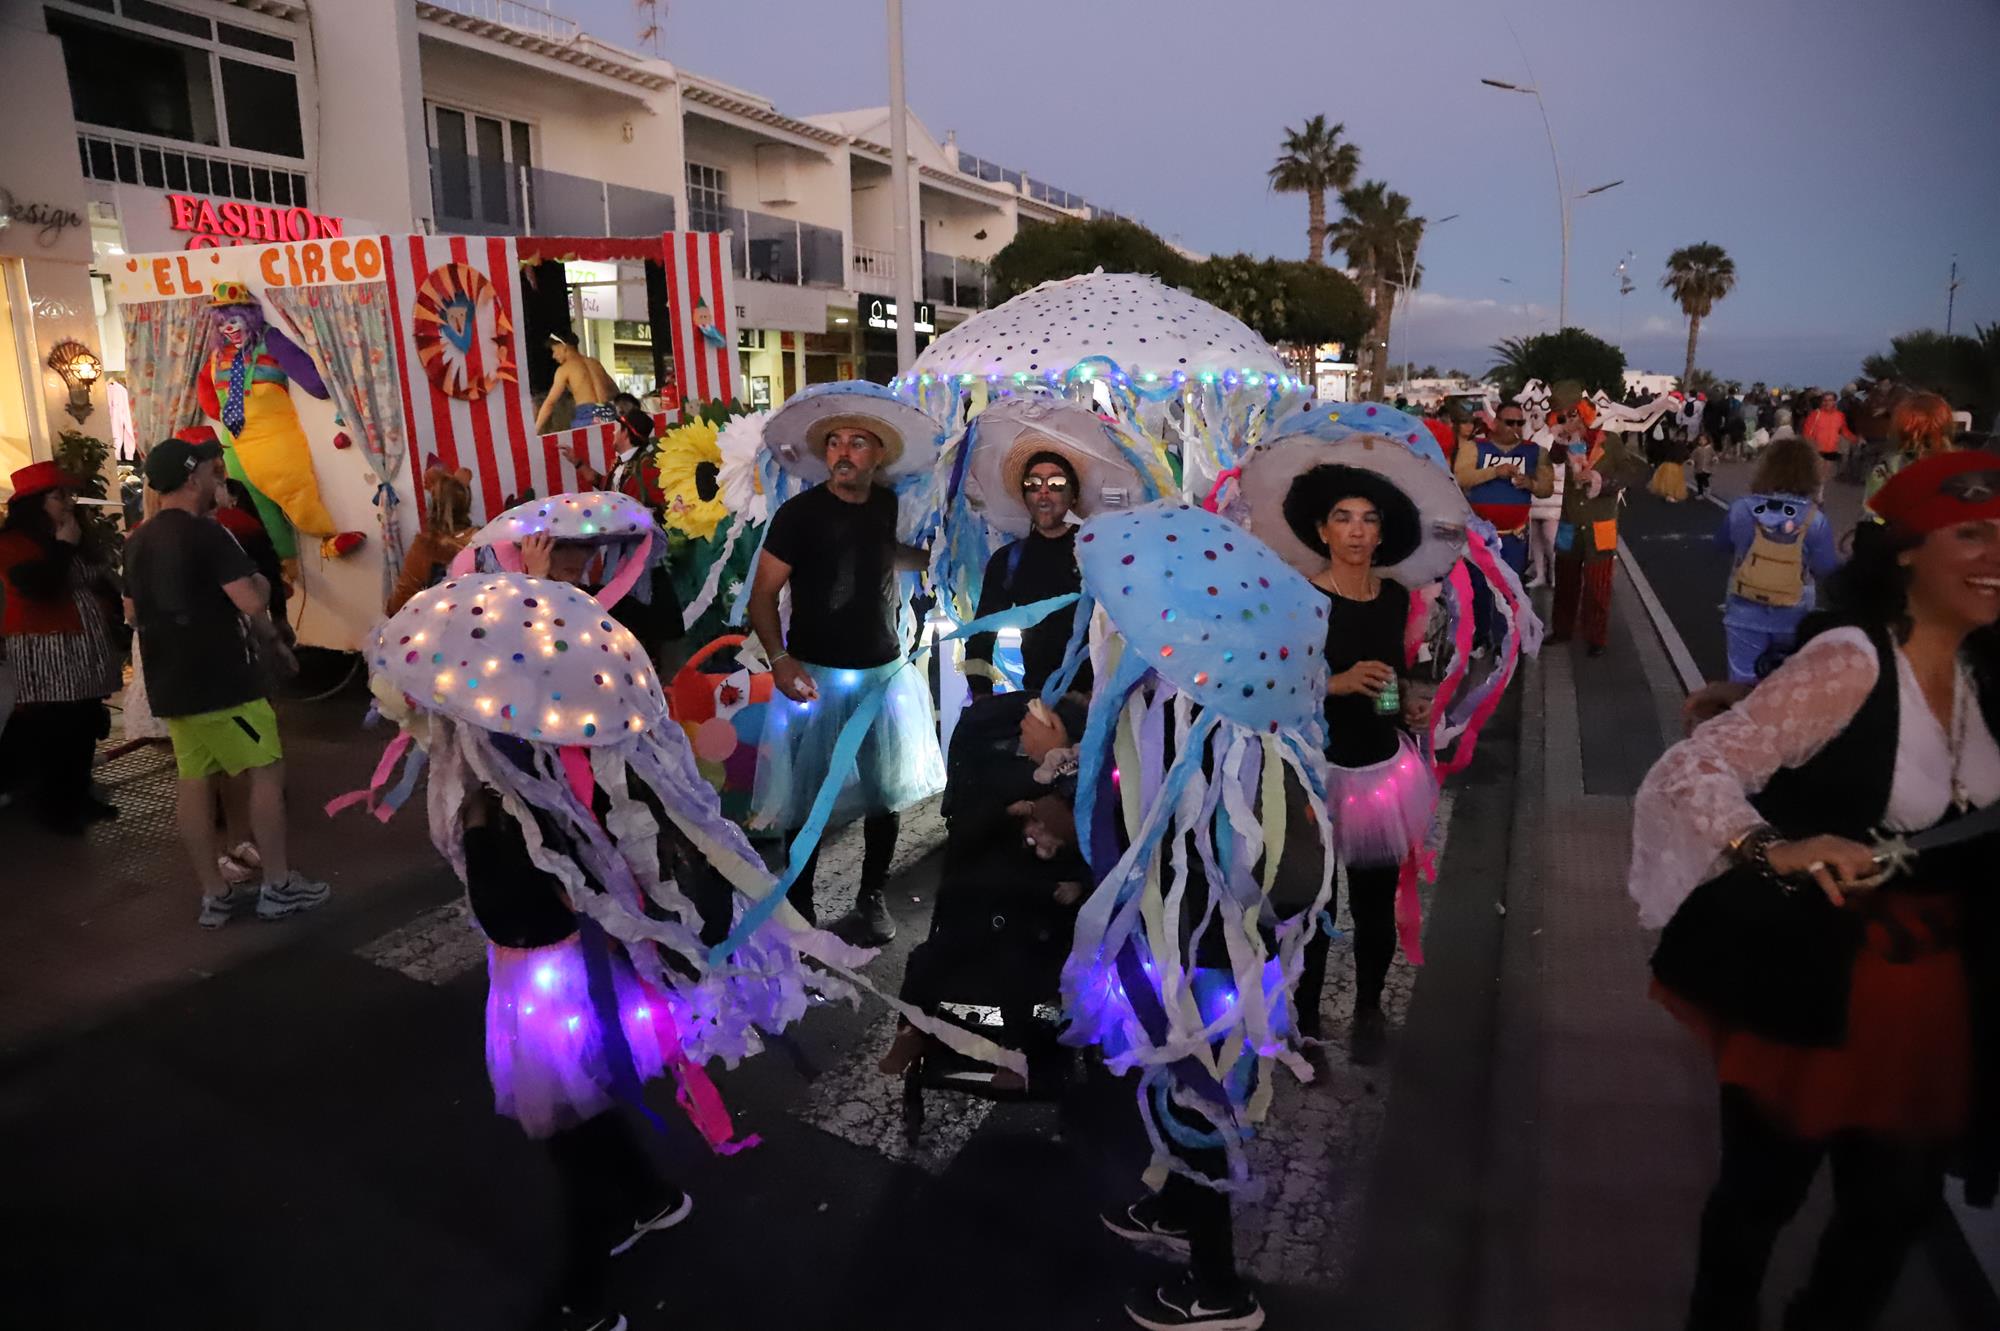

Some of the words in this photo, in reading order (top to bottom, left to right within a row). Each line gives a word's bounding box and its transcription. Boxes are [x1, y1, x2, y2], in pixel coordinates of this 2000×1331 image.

[168, 194, 343, 242] FASHION
[152, 256, 203, 296] EL
[260, 238, 382, 287] CIRCO
